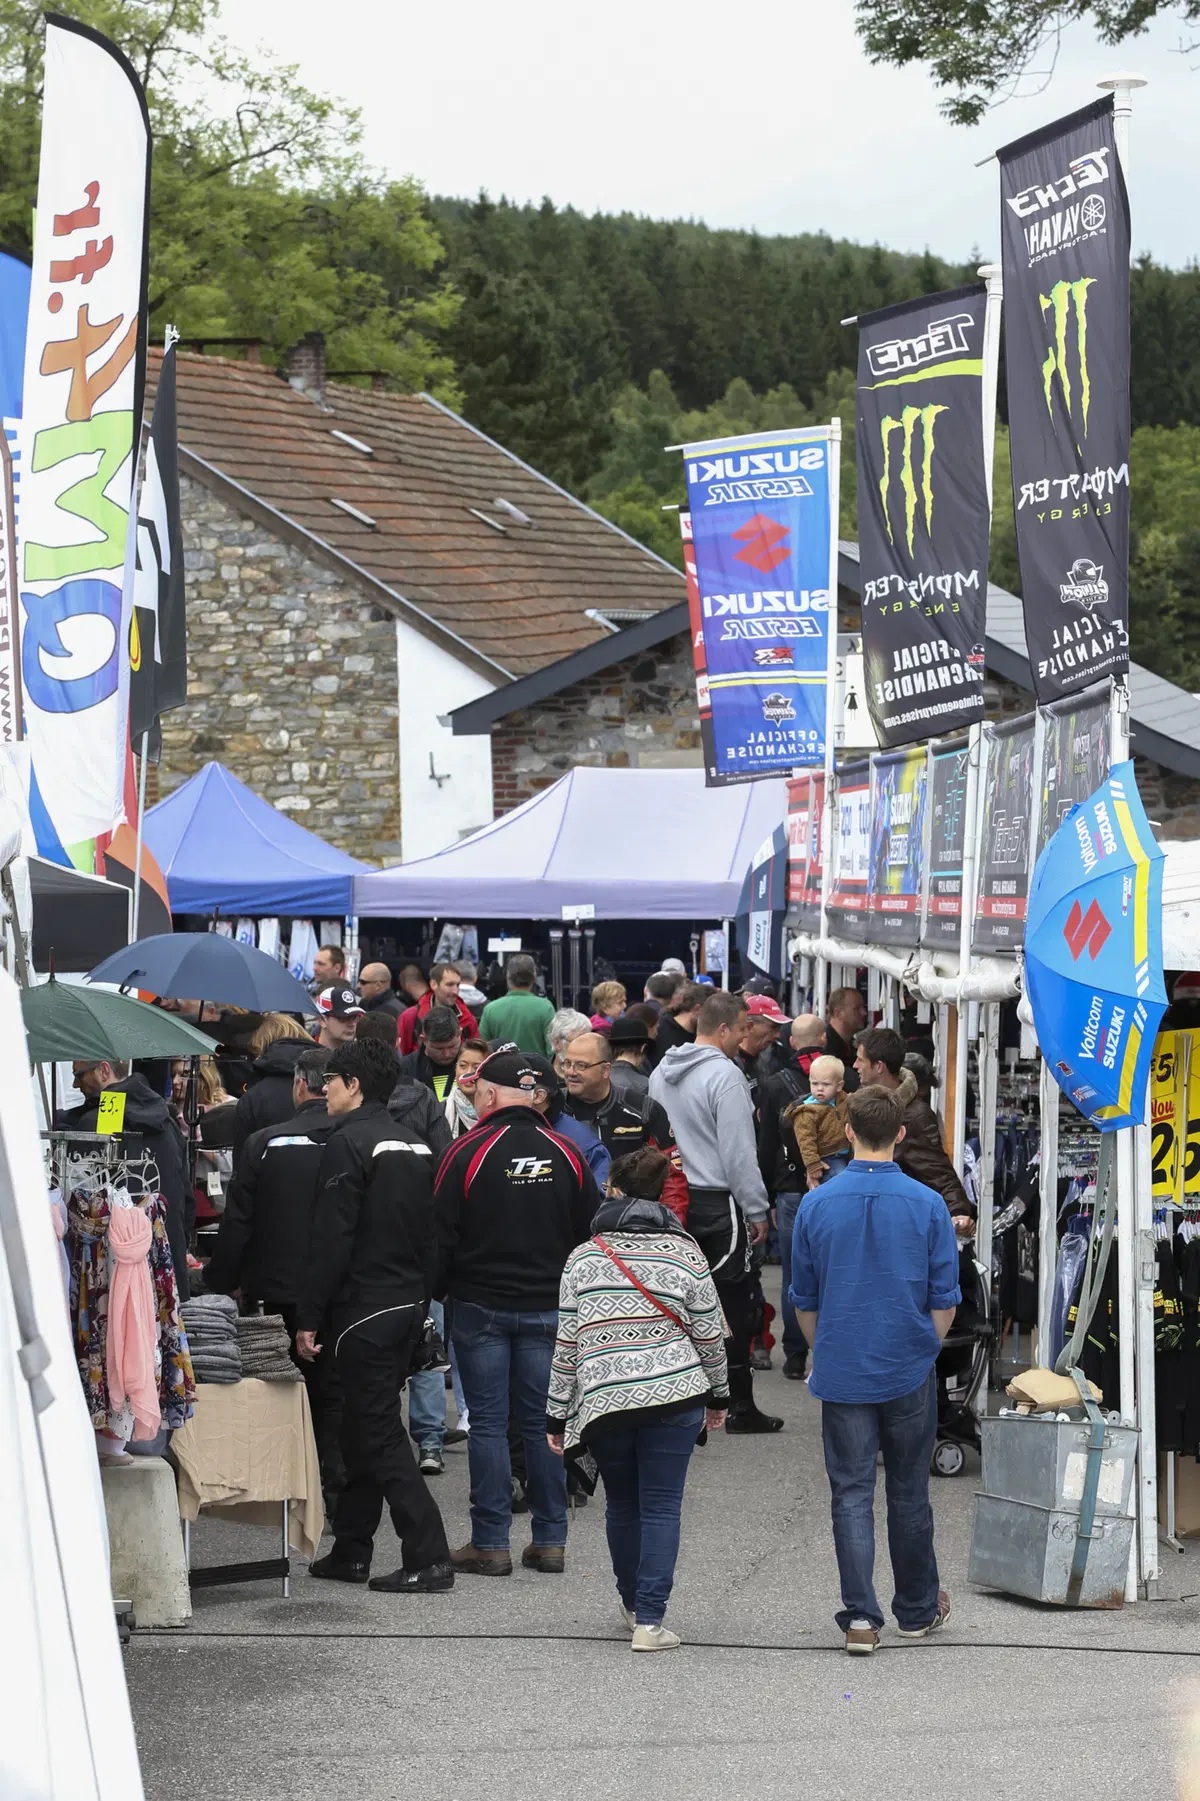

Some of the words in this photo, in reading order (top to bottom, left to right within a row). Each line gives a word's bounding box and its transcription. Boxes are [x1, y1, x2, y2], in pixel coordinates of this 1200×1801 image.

[1075, 815, 1099, 875] Voltcom
[1094, 800, 1118, 855] SUZUKI
[1078, 996, 1104, 1060] Voltcom
[1103, 1006, 1126, 1070] SUZUKI
[511, 1156, 553, 1178] TT
